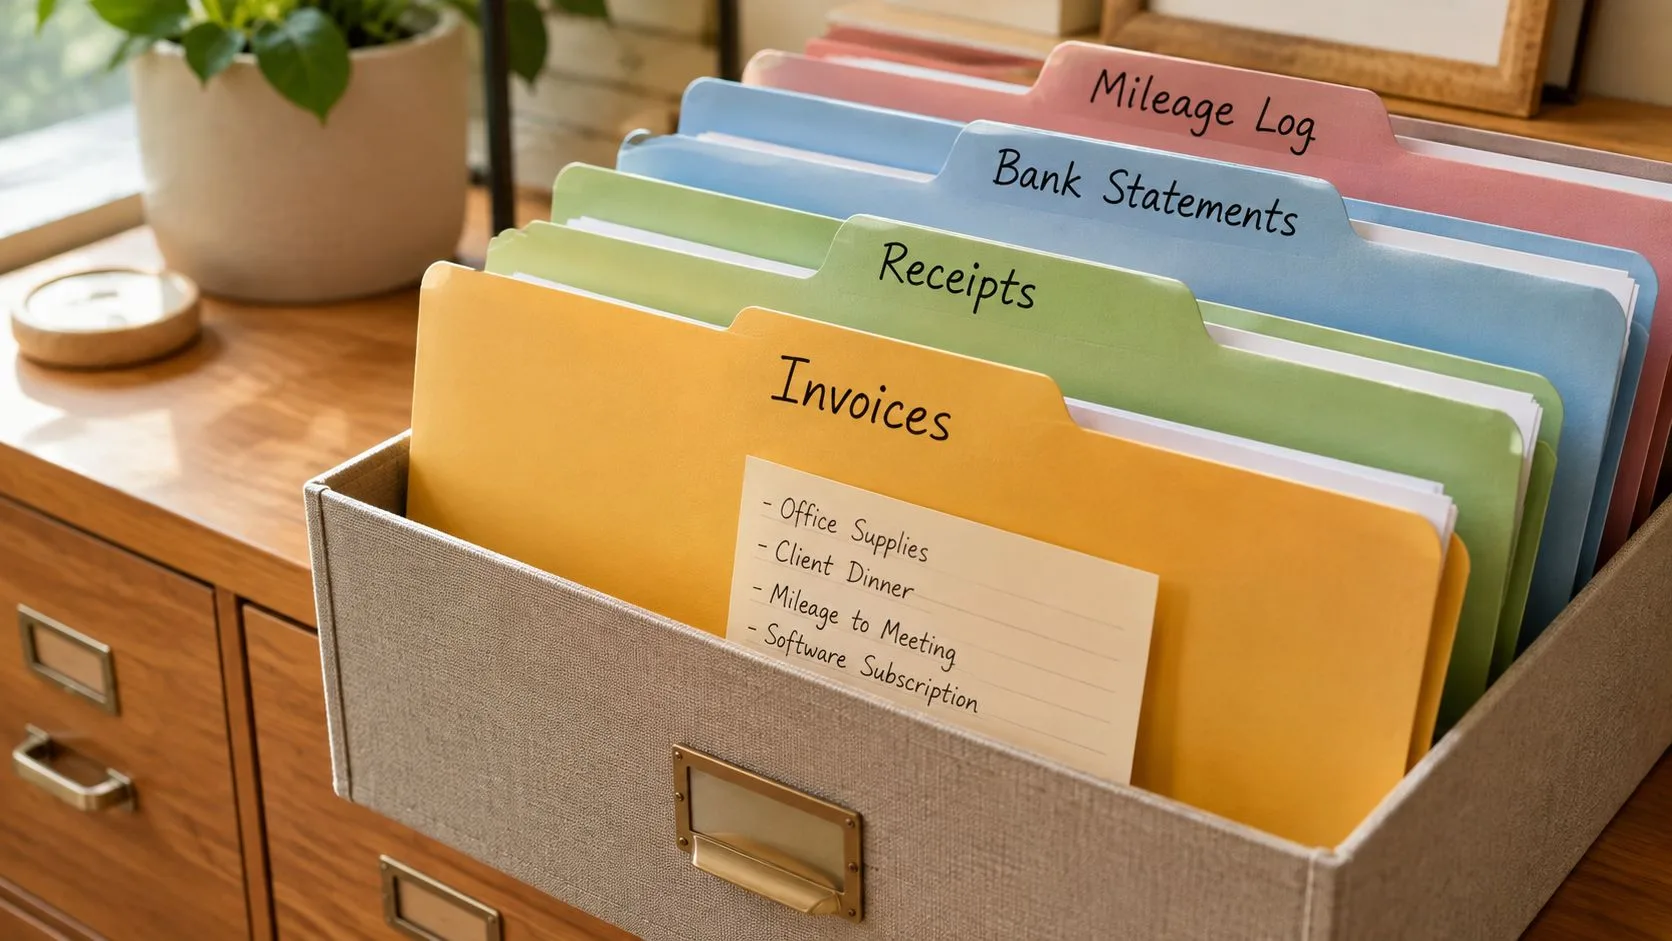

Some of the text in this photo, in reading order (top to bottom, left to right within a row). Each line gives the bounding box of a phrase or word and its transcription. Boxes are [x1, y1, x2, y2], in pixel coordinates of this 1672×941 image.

[1090, 69, 1317, 156] Mileage Log
[992, 148, 1299, 237] Bank Statements
[878, 242, 1036, 314] Receipts
[770, 355, 952, 442] Invoices
[774, 539, 835, 577] Client
[845, 561, 915, 600] Dinner
[780, 496, 838, 535] Office
[850, 519, 929, 564] Supplies
[763, 623, 847, 669] Software
[859, 655, 979, 714] Subscription
[769, 583, 839, 631] Mileage
[851, 609, 870, 633] to
[879, 619, 957, 673] Meeting
